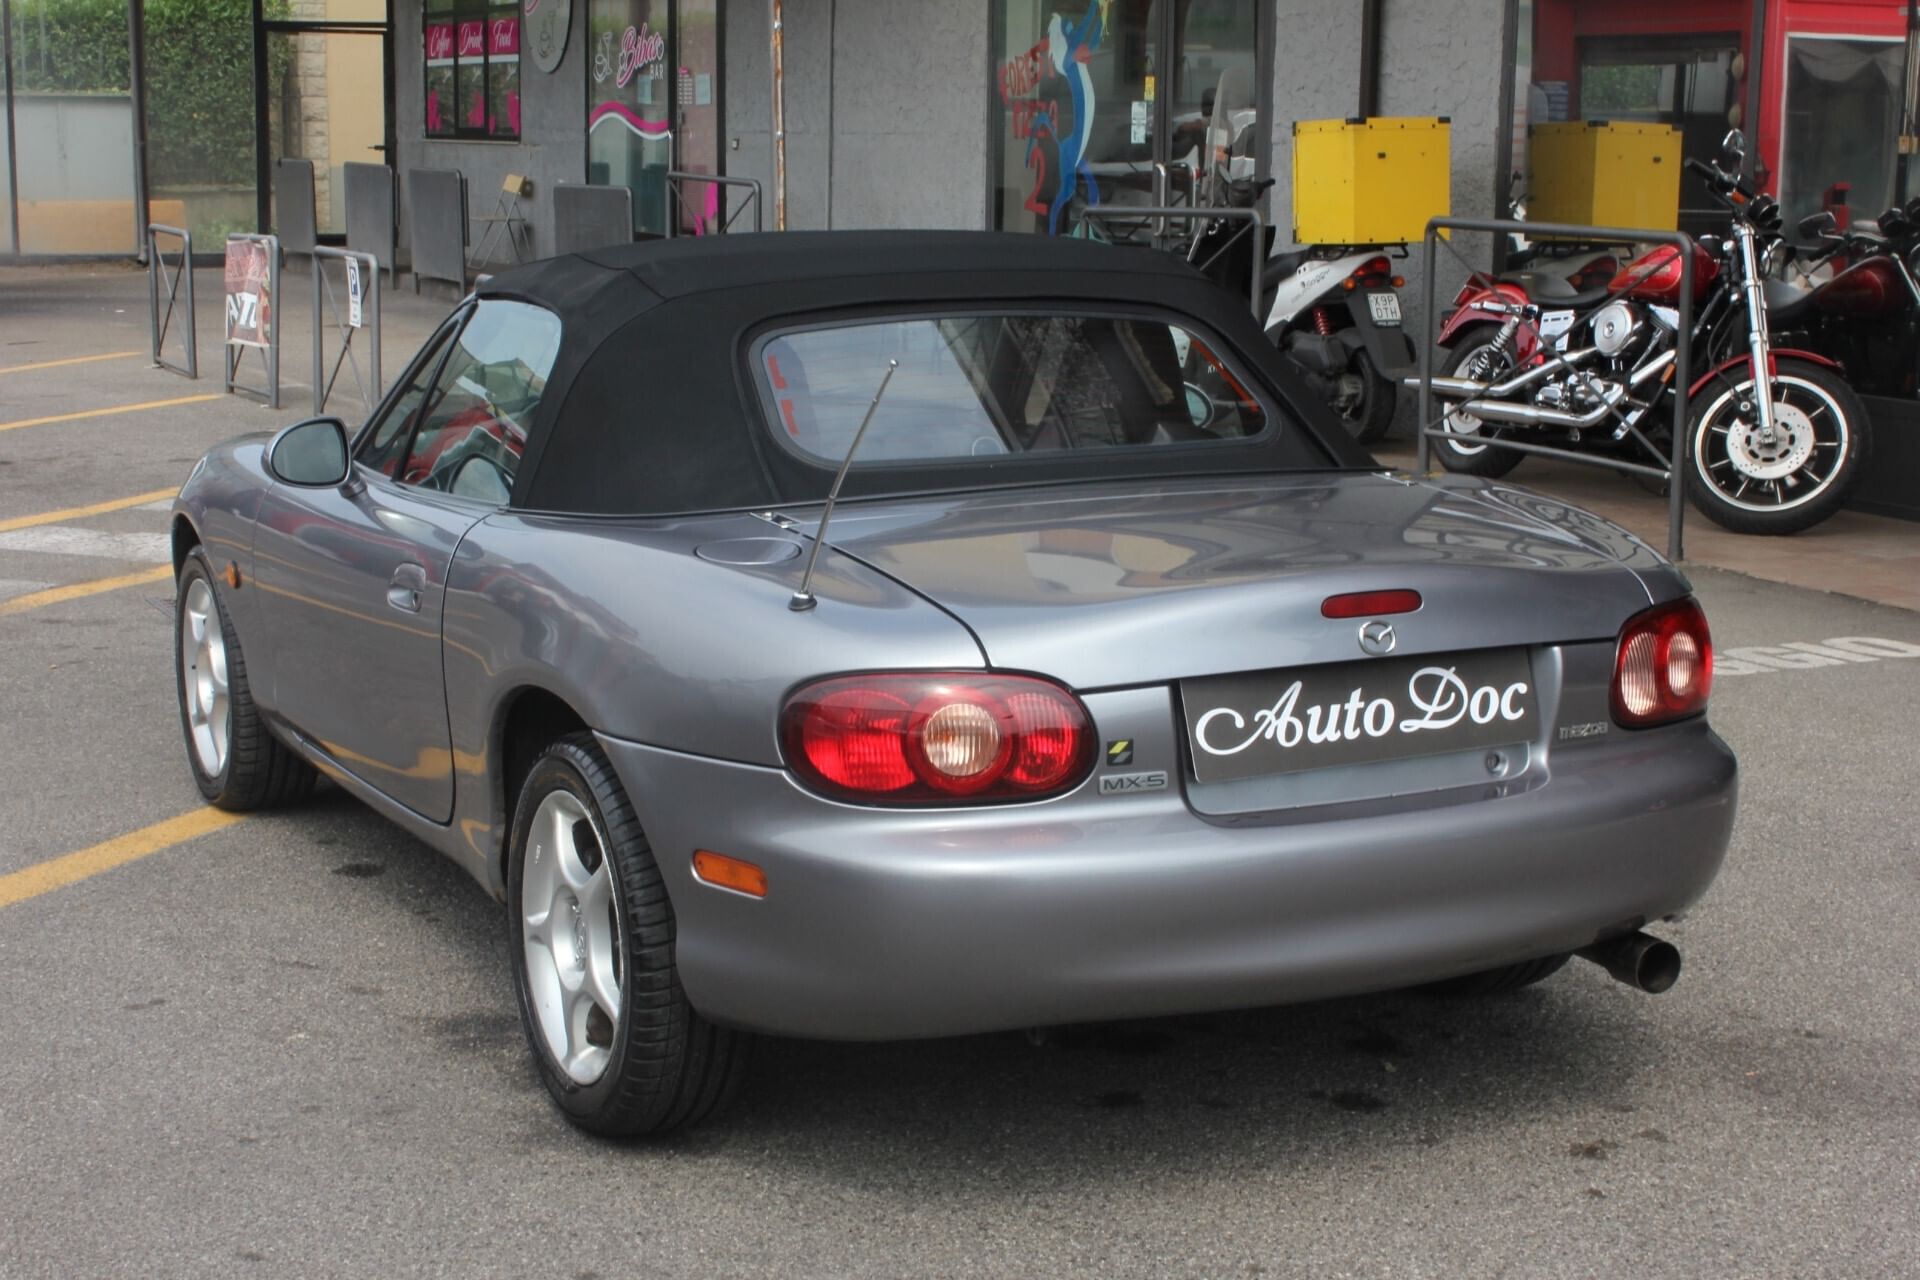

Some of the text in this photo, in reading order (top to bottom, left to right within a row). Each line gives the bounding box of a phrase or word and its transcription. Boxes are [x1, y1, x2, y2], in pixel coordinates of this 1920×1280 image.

[459, 24, 483, 55] Drink
[493, 20, 514, 50] Food
[650, 64, 664, 80] BAR
[1024, 147, 1048, 216] 2
[1373, 295, 1394, 306] X9P
[1103, 774, 1165, 791] MX-5
